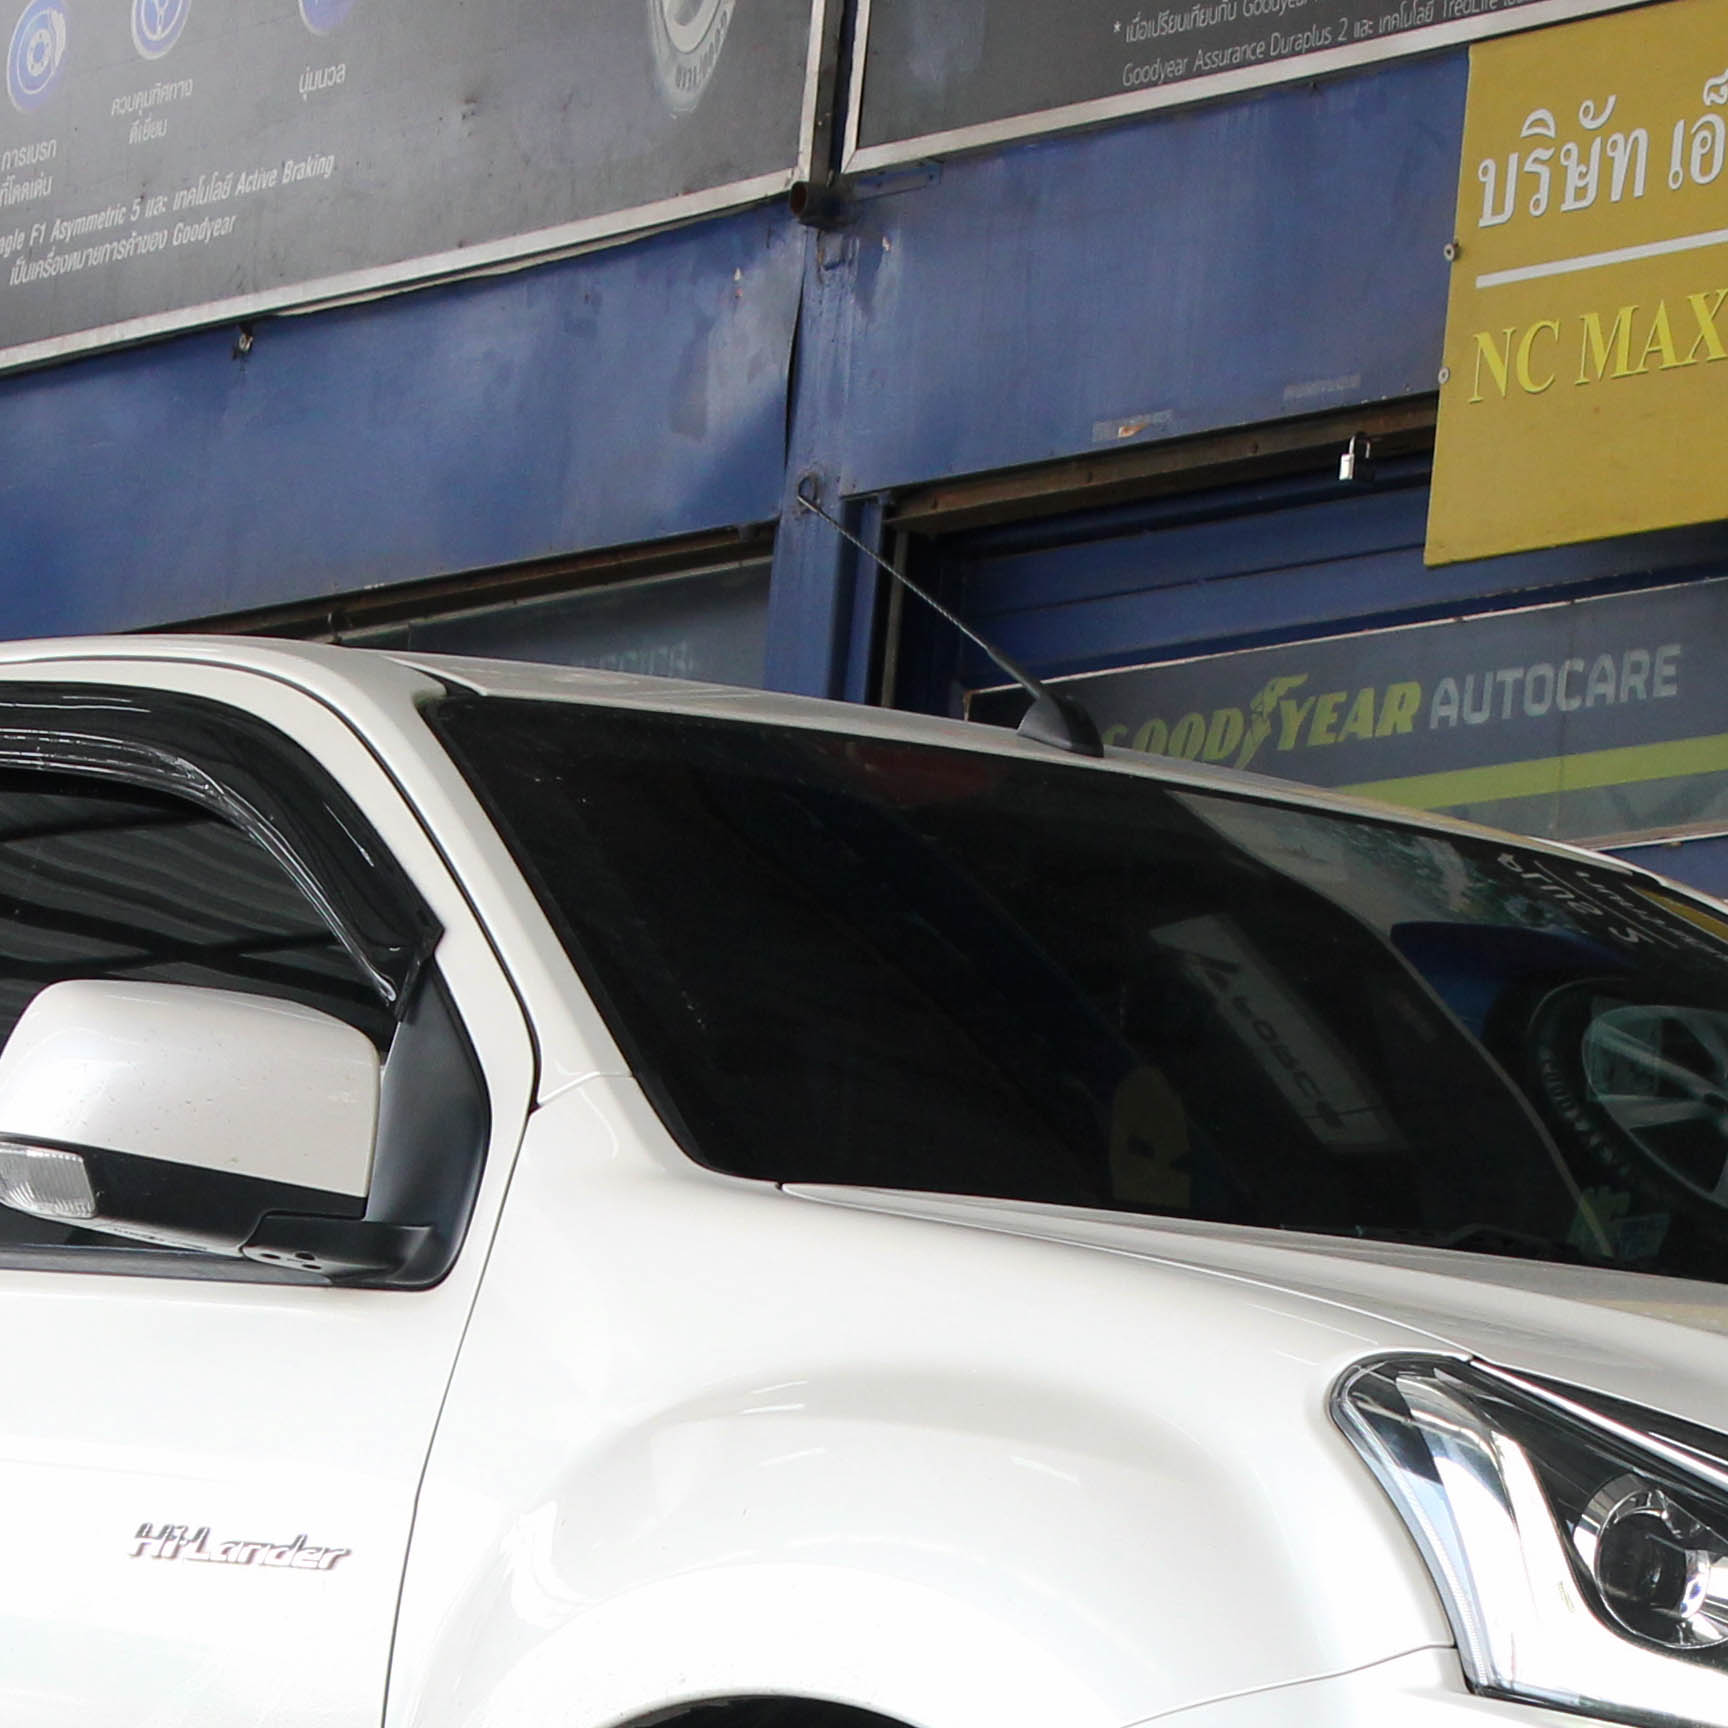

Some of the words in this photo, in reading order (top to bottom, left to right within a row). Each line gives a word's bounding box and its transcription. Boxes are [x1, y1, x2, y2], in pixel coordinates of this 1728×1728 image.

[1123, 56, 1188, 88] Goodyear
[1192, 44, 1265, 72] Assurance
[1270, 26, 1333, 57] Duraplus
[1337, 17, 1348, 42] 2
[0, 138, 57, 171] การเบรก
[1477, 94, 1649, 229] บริษัท
[29, 223, 46, 247] F1
[50, 203, 127, 244] Asymmetric
[130, 198, 141, 222] 5
[235, 168, 278, 196] Active
[281, 153, 336, 184] Braking
[172, 214, 237, 248] Goodyear
[1467, 318, 1562, 402] NC
[1428, 643, 1682, 730] AUTOCARE
